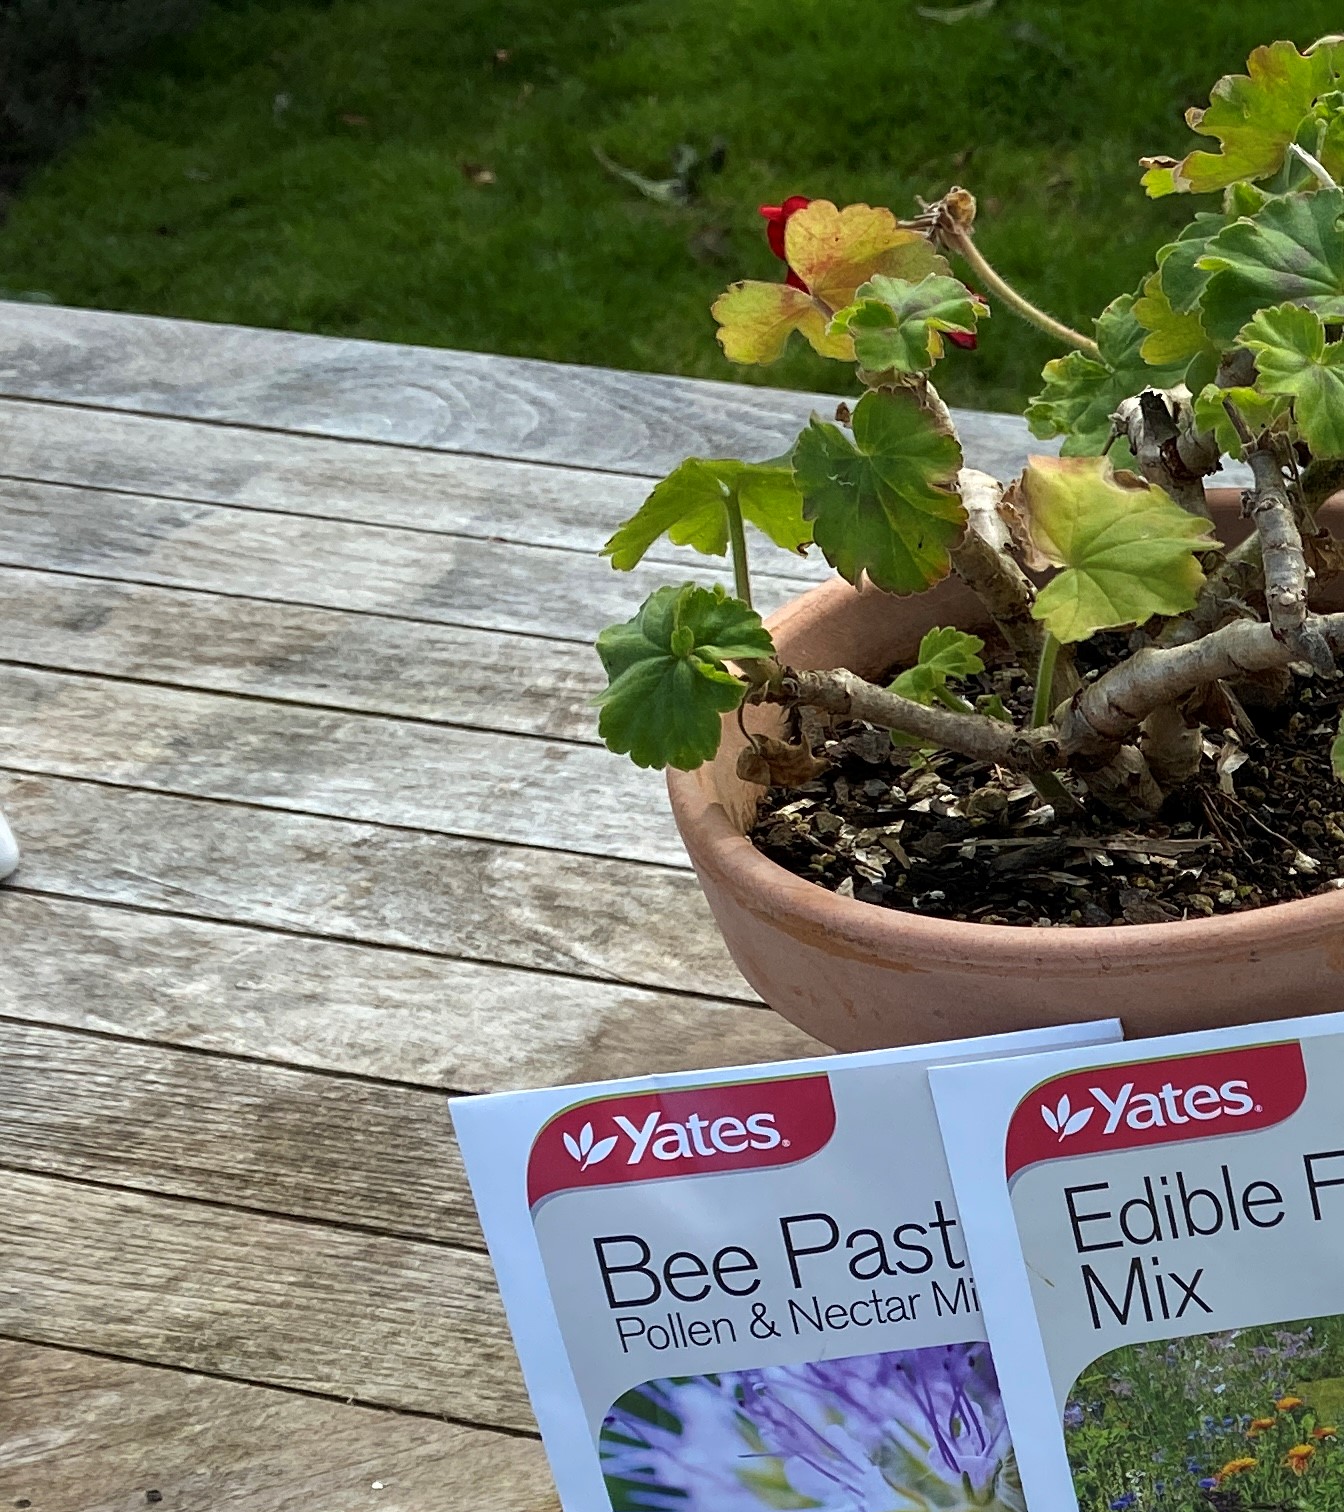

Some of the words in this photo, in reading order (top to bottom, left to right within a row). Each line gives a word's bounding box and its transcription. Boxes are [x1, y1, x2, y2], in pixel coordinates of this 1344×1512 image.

[613, 1111, 780, 1165] Yates
[1089, 1080, 1256, 1136] Yates
[1064, 1165, 1287, 1254] Edible
[593, 1233, 762, 1309] Bee
[779, 1200, 966, 1290] Past
[616, 1311, 738, 1353] Pollen
[749, 1303, 780, 1340] &
[789, 1291, 922, 1336] Nectar
[930, 1278, 981, 1318] Mi
[1081, 1256, 1214, 1330] Mix
